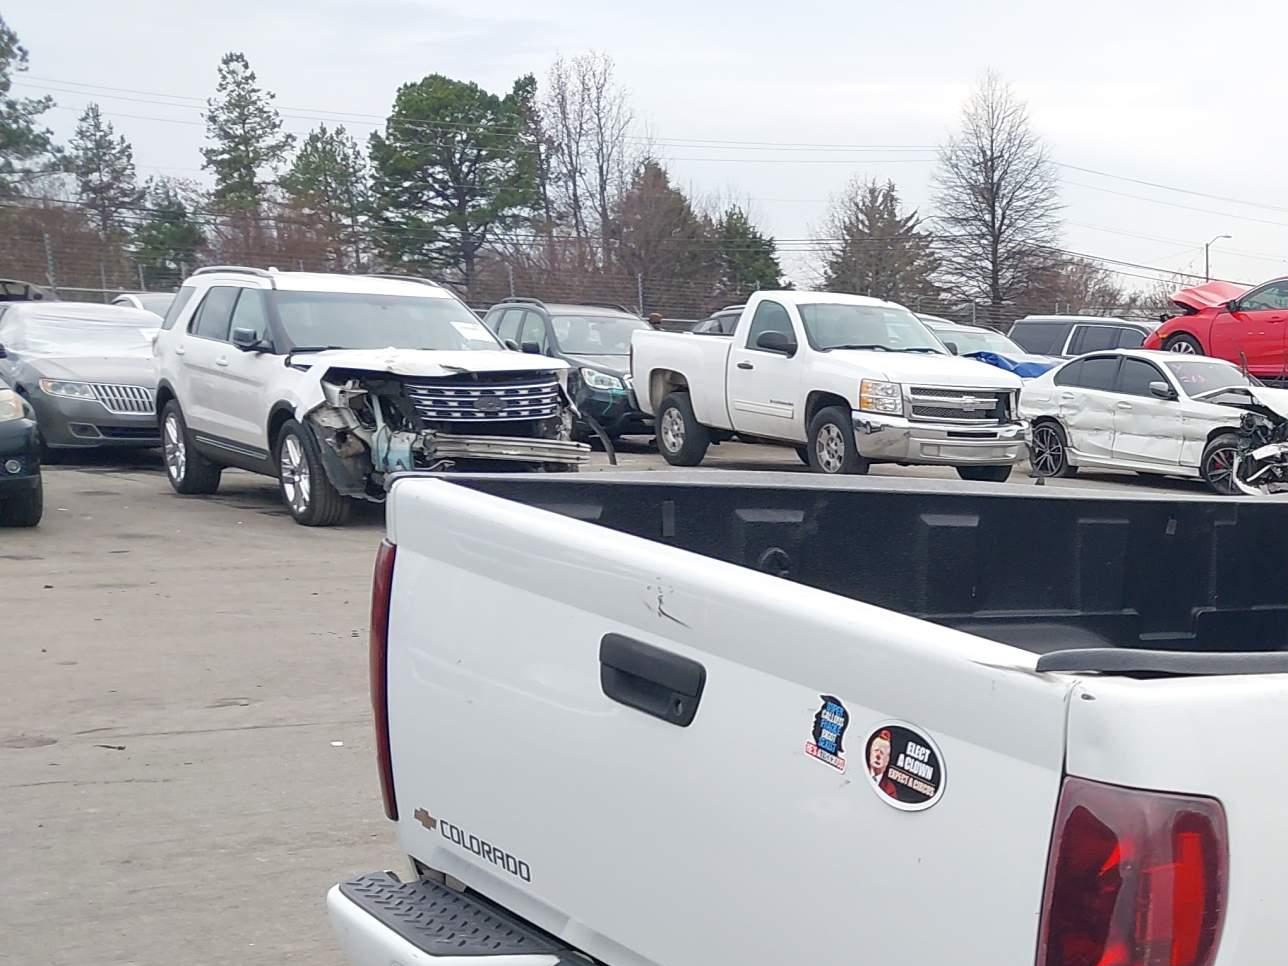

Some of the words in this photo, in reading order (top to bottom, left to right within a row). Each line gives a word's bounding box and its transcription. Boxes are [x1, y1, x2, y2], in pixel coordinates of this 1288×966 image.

[905, 741, 931, 763] ELECT
[887, 768, 910, 785] EXPECT
[907, 777, 914, 788] A
[896, 753, 905, 768] A
[904, 756, 933, 781] CLOWN
[439, 819, 531, 882] COLORADO
